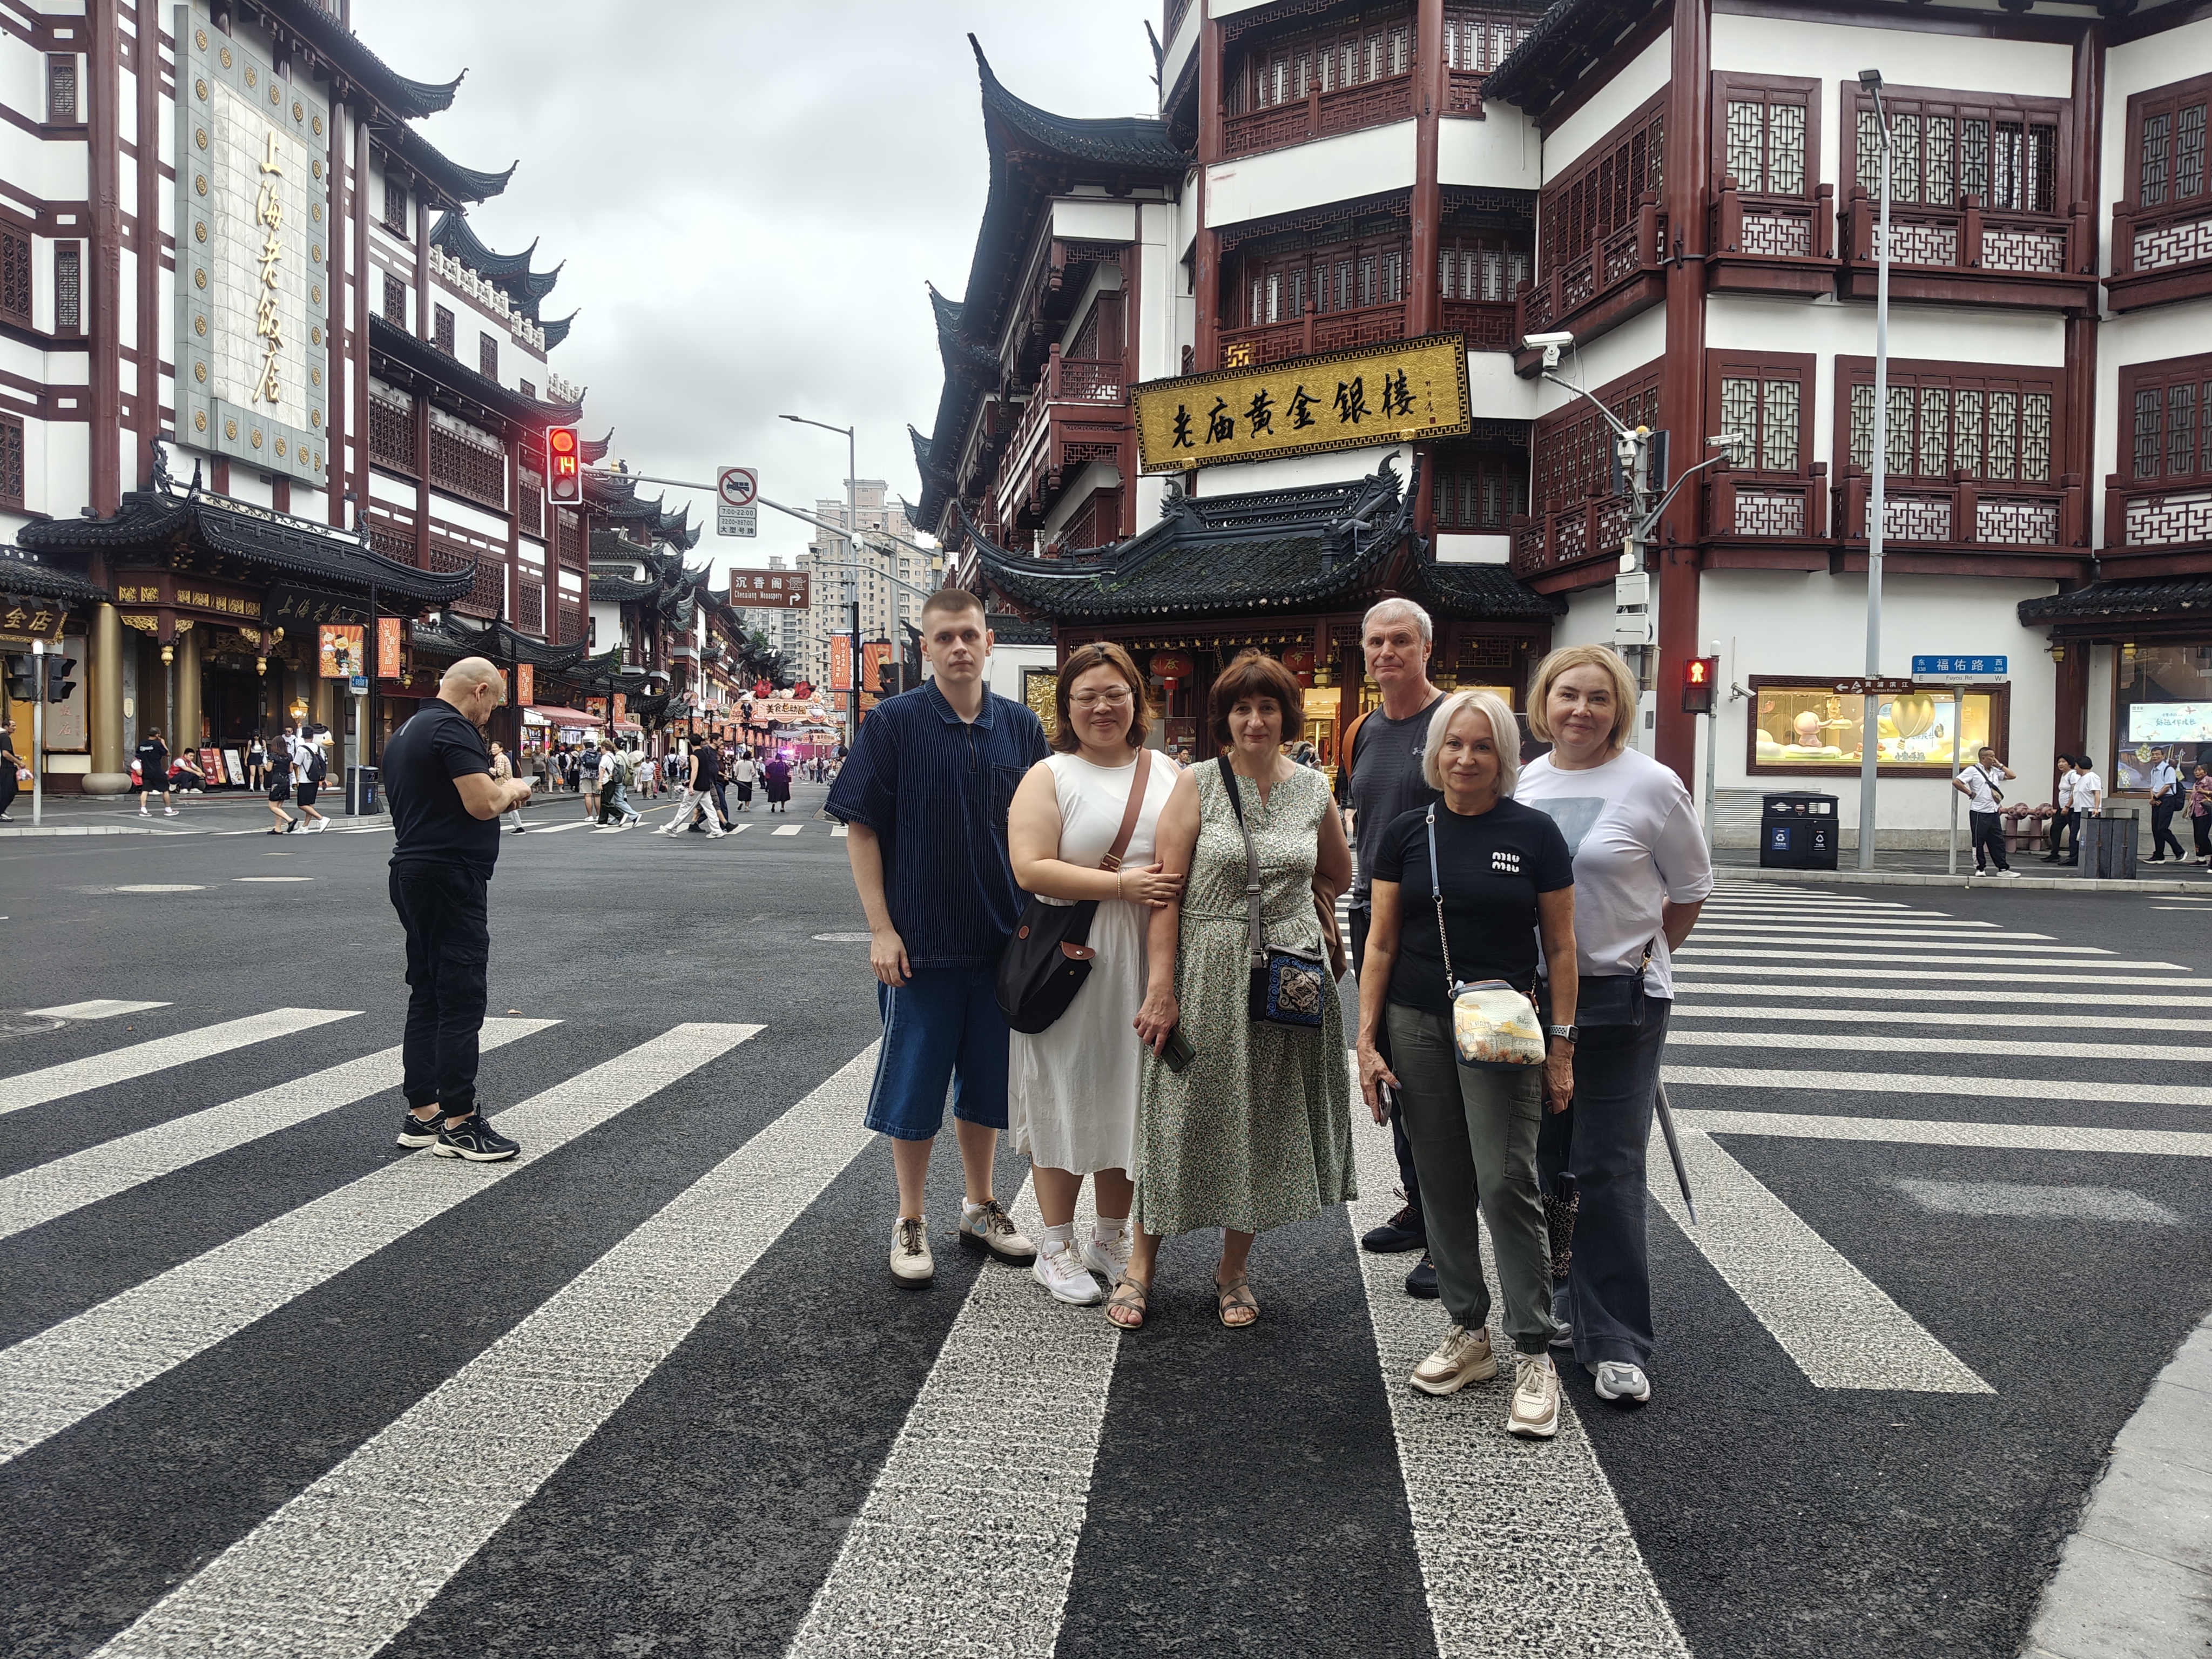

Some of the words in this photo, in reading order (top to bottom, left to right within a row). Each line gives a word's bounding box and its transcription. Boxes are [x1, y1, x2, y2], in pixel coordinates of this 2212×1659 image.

[560, 457, 575, 474] 14
[720, 526, 754, 535] 大型号牌
[735, 576, 782, 589] 沉香阁
[734, 590, 757, 601] Chenxiang
[4, 606, 54, 632] 金店
[1937, 659, 1984, 671] 福佑路
[766, 703, 806, 714] 美食总动园
[1492, 852, 1520, 862] miu
[1492, 861, 1520, 873] miu
